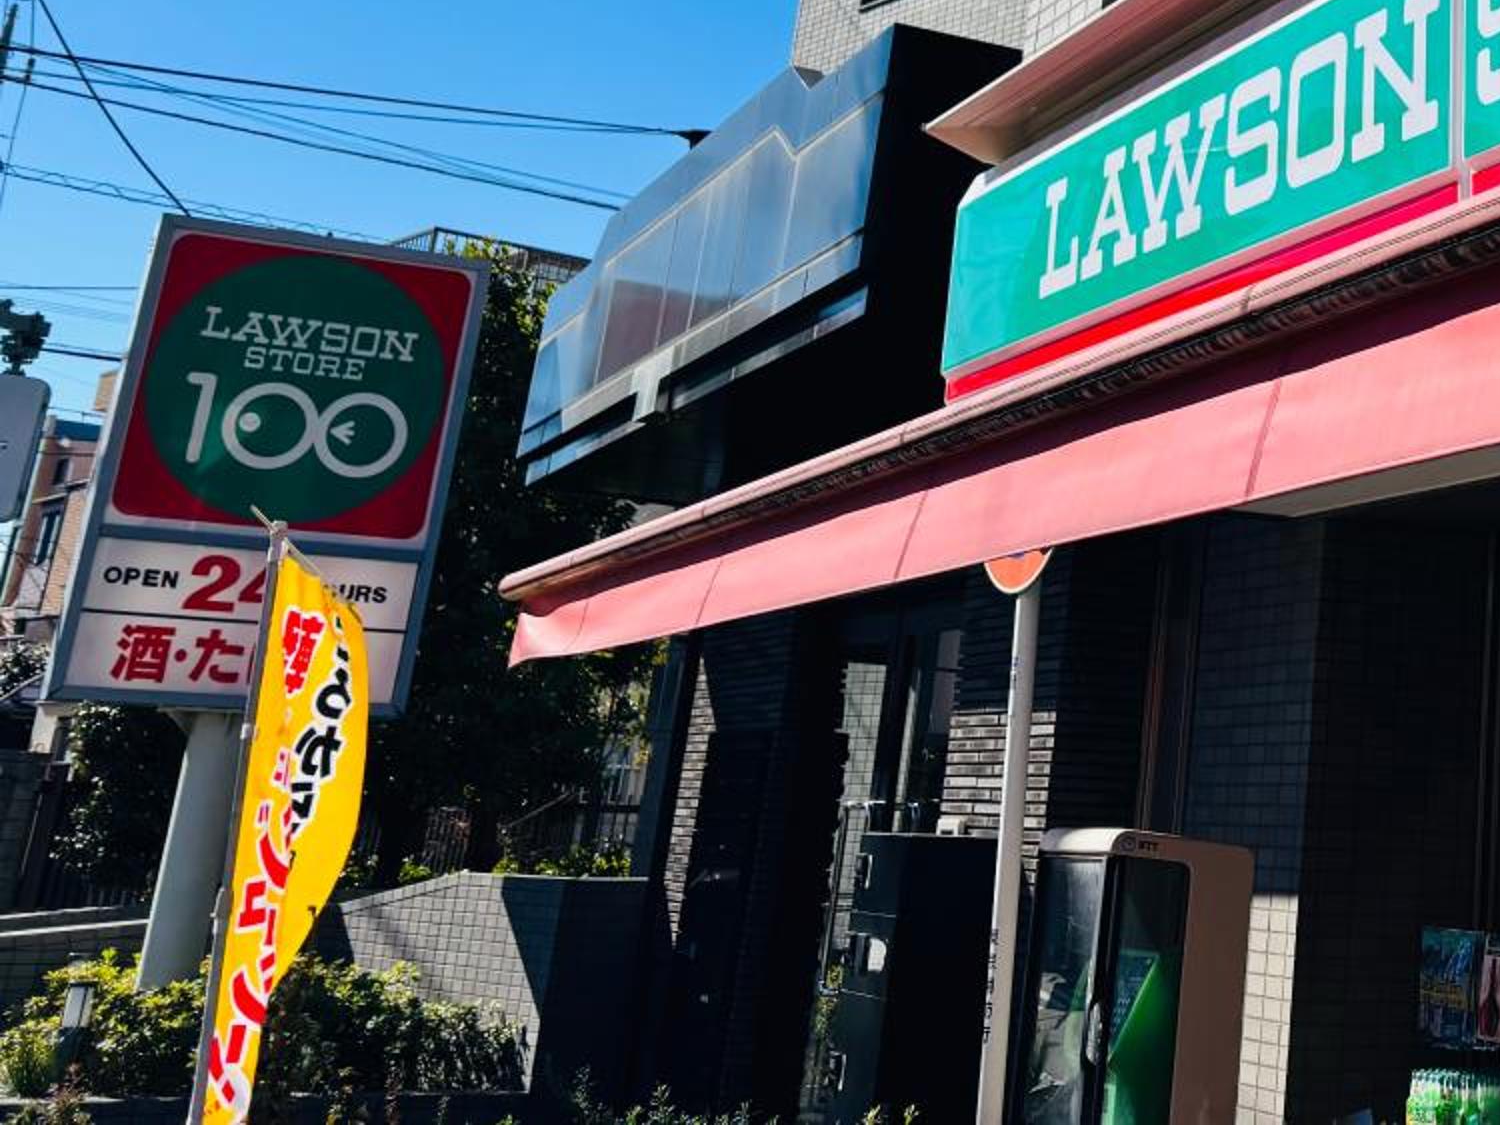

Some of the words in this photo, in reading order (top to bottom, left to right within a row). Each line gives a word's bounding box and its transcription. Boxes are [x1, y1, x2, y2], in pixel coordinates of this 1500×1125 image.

[200, 305, 419, 364] LAWSON
[244, 345, 366, 381] STORE
[185, 372, 409, 478] 100
[103, 565, 180, 591] OPEN
[110, 624, 258, 686] 酒・た
